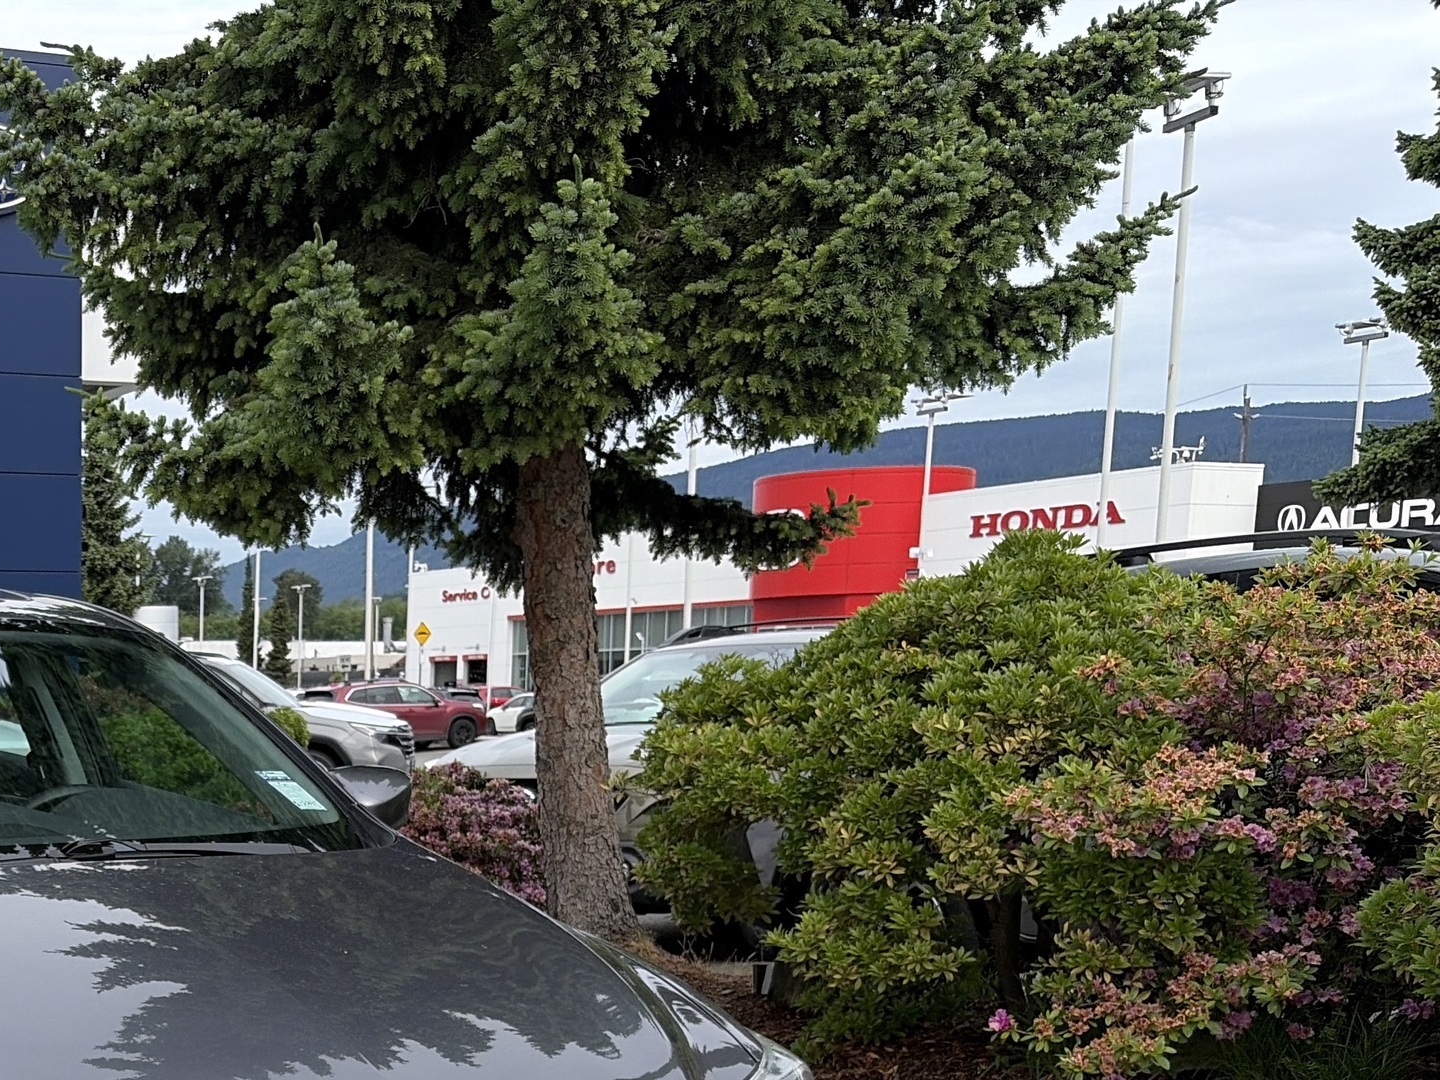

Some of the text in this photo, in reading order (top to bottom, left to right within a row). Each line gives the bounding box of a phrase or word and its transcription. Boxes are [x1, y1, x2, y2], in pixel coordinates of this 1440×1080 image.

[969, 500, 1126, 538] HONDA
[1310, 498, 1440, 529] ACUR
[442, 588, 478, 603] Service
